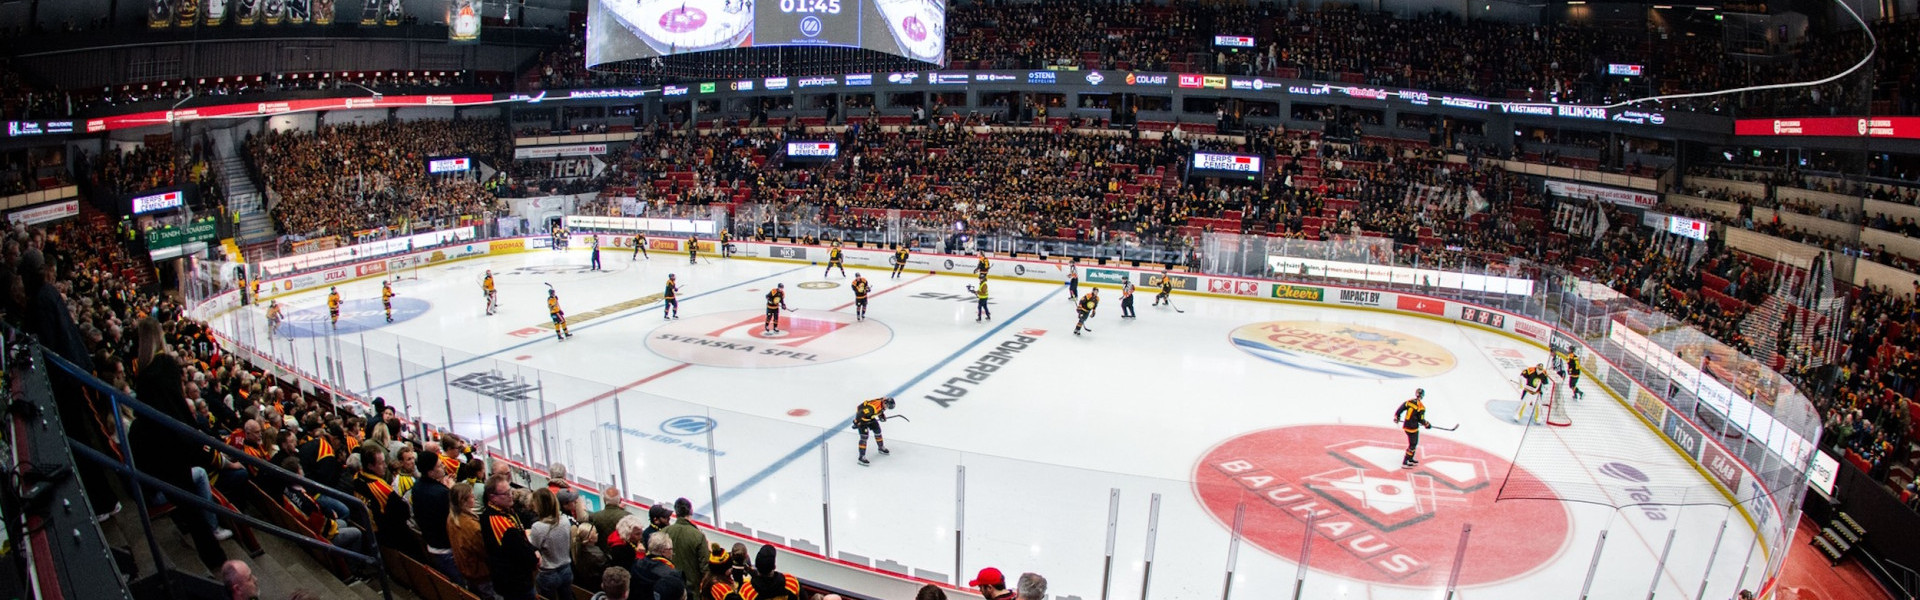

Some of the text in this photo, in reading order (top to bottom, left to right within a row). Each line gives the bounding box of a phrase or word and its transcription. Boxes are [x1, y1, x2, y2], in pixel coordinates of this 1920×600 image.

[1136, 75, 1168, 84] COLABIT
[1289, 86, 1309, 94] CALL
[1558, 106, 1606, 119] BILINORR
[1203, 154, 1232, 162] TIERPS
[550, 158, 591, 178] ITEM
[1203, 161, 1237, 170] CEMENT
[140, 195, 162, 205] TIERPS
[140, 199, 176, 212] CEMENT AB
[780, 248, 796, 257] NKB
[325, 271, 346, 281] JULA
[1276, 285, 1318, 300] Cheers
[1340, 289, 1380, 302] IMPACT BY
[655, 334, 818, 361] SVENSKA SPEL
[1259, 324, 1446, 367] NORRLANDS
[1267, 333, 1412, 368] GULD
[924, 334, 1037, 408] POWERPLAY
[650, 434, 682, 445] ERP
[679, 442, 727, 457] Arena
[1624, 485, 1667, 522] Telia
[1219, 459, 1420, 574] BAUHAUS
